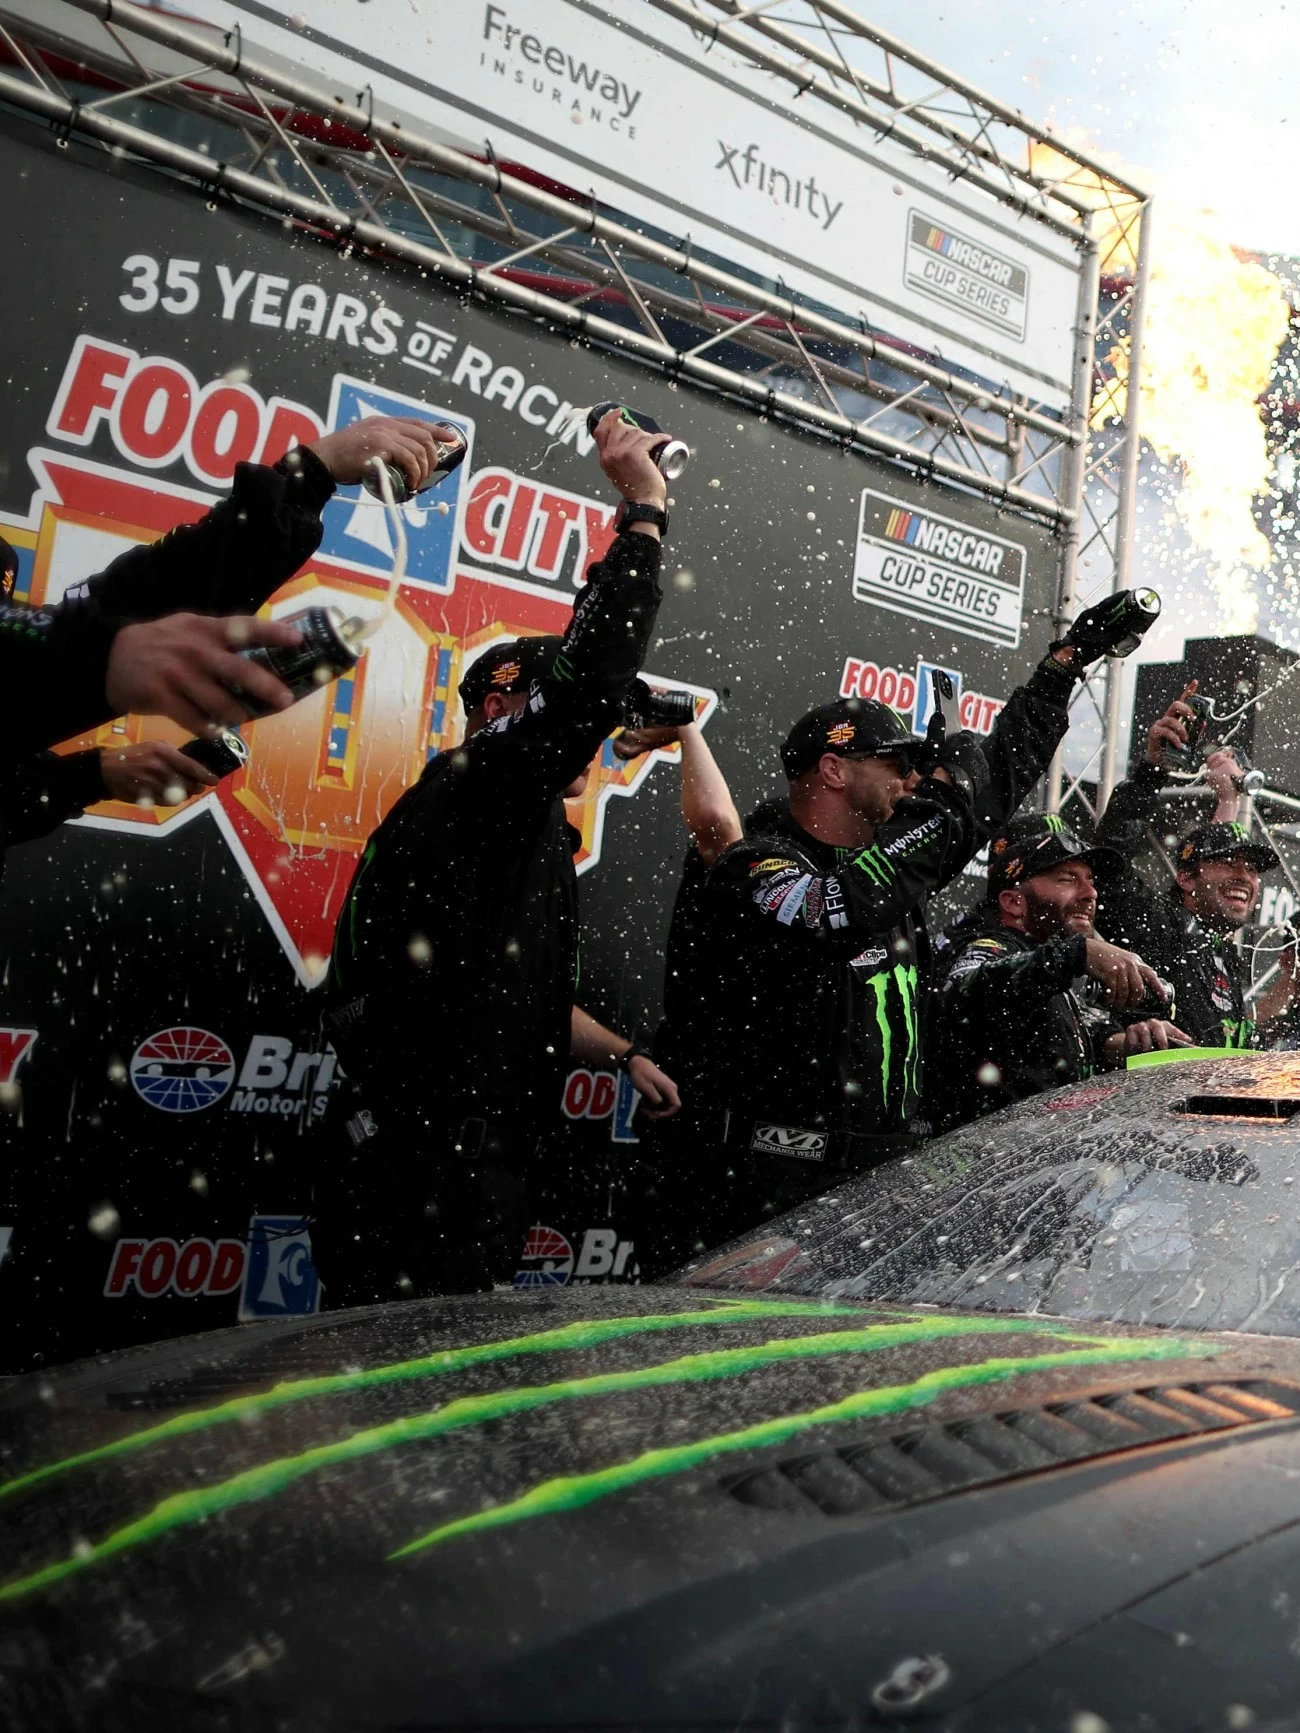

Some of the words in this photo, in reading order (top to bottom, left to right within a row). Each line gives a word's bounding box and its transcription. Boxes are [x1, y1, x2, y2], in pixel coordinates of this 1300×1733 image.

[482, 4, 641, 118] Freeway
[479, 52, 638, 139] INSURANCE
[715, 139, 844, 230] xfinity
[923, 260, 956, 293] CUP
[958, 274, 1010, 316] SERIES
[946, 236, 1013, 287] NASCAR
[119, 254, 200, 315] 35
[215, 264, 405, 356] YEARS
[407, 332, 454, 367] OF
[451, 343, 597, 458] RACIN
[51, 338, 324, 487] FOOD
[914, 513, 1004, 574] NASCAR
[880, 556, 925, 595] CUP
[926, 571, 1001, 618] SERIES
[842, 661, 915, 711] FOOD
[961, 692, 1006, 735] CIT
[826, 726, 856, 743] 35
[884, 812, 945, 856] MONSTER
[902, 828, 944, 858] ENERGY
[231, 1091, 302, 1115] Motor
[753, 1139, 795, 1155] MECHANIX
[797, 1147, 824, 1160] WEAR
[105, 1239, 244, 1297] FOOD
